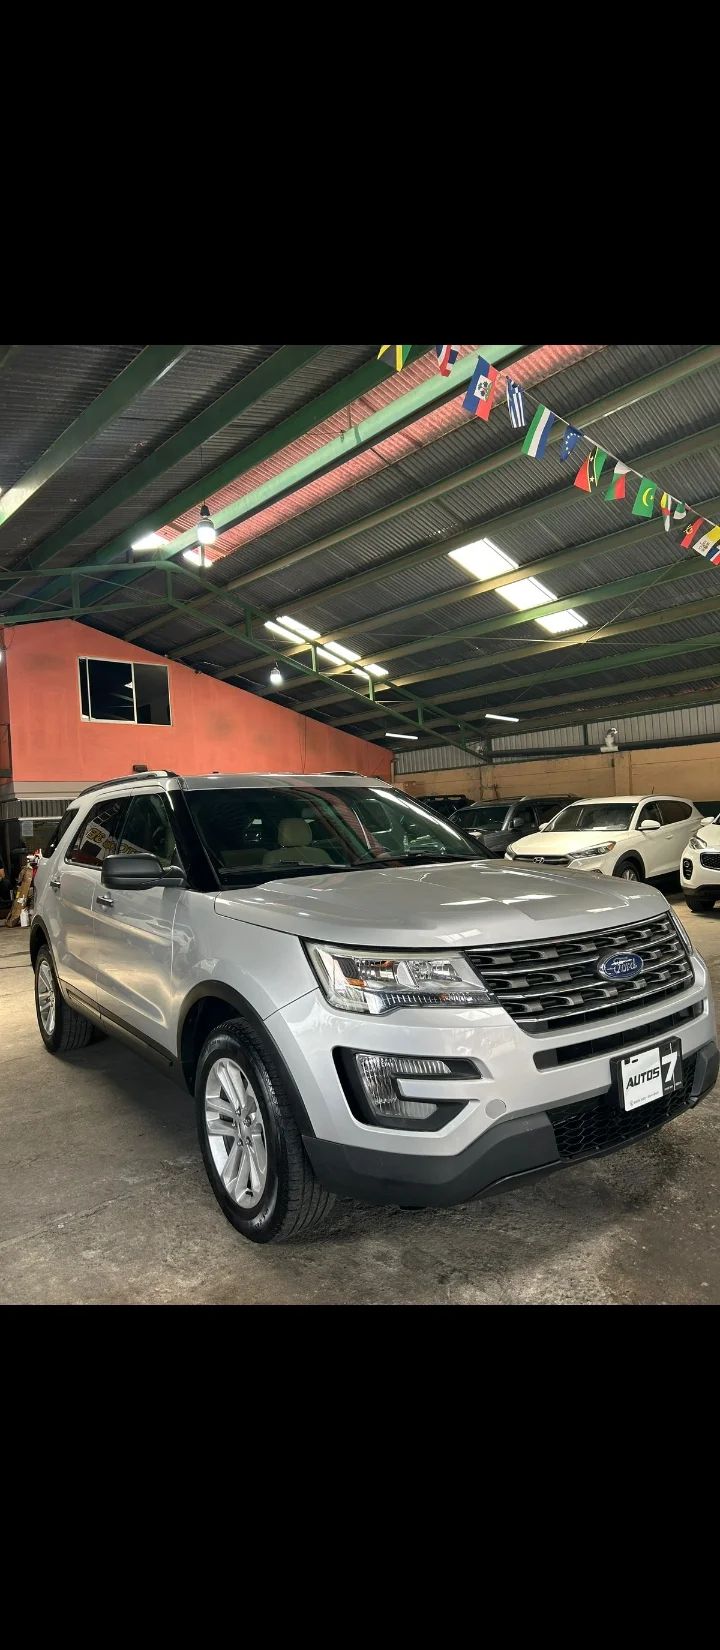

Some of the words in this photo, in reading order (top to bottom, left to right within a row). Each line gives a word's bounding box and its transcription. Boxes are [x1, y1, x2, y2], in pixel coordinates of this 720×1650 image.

[606, 956, 638, 975] Ford
[626, 1066, 660, 1089] AUTOS
[662, 1051, 677, 1082] 7
